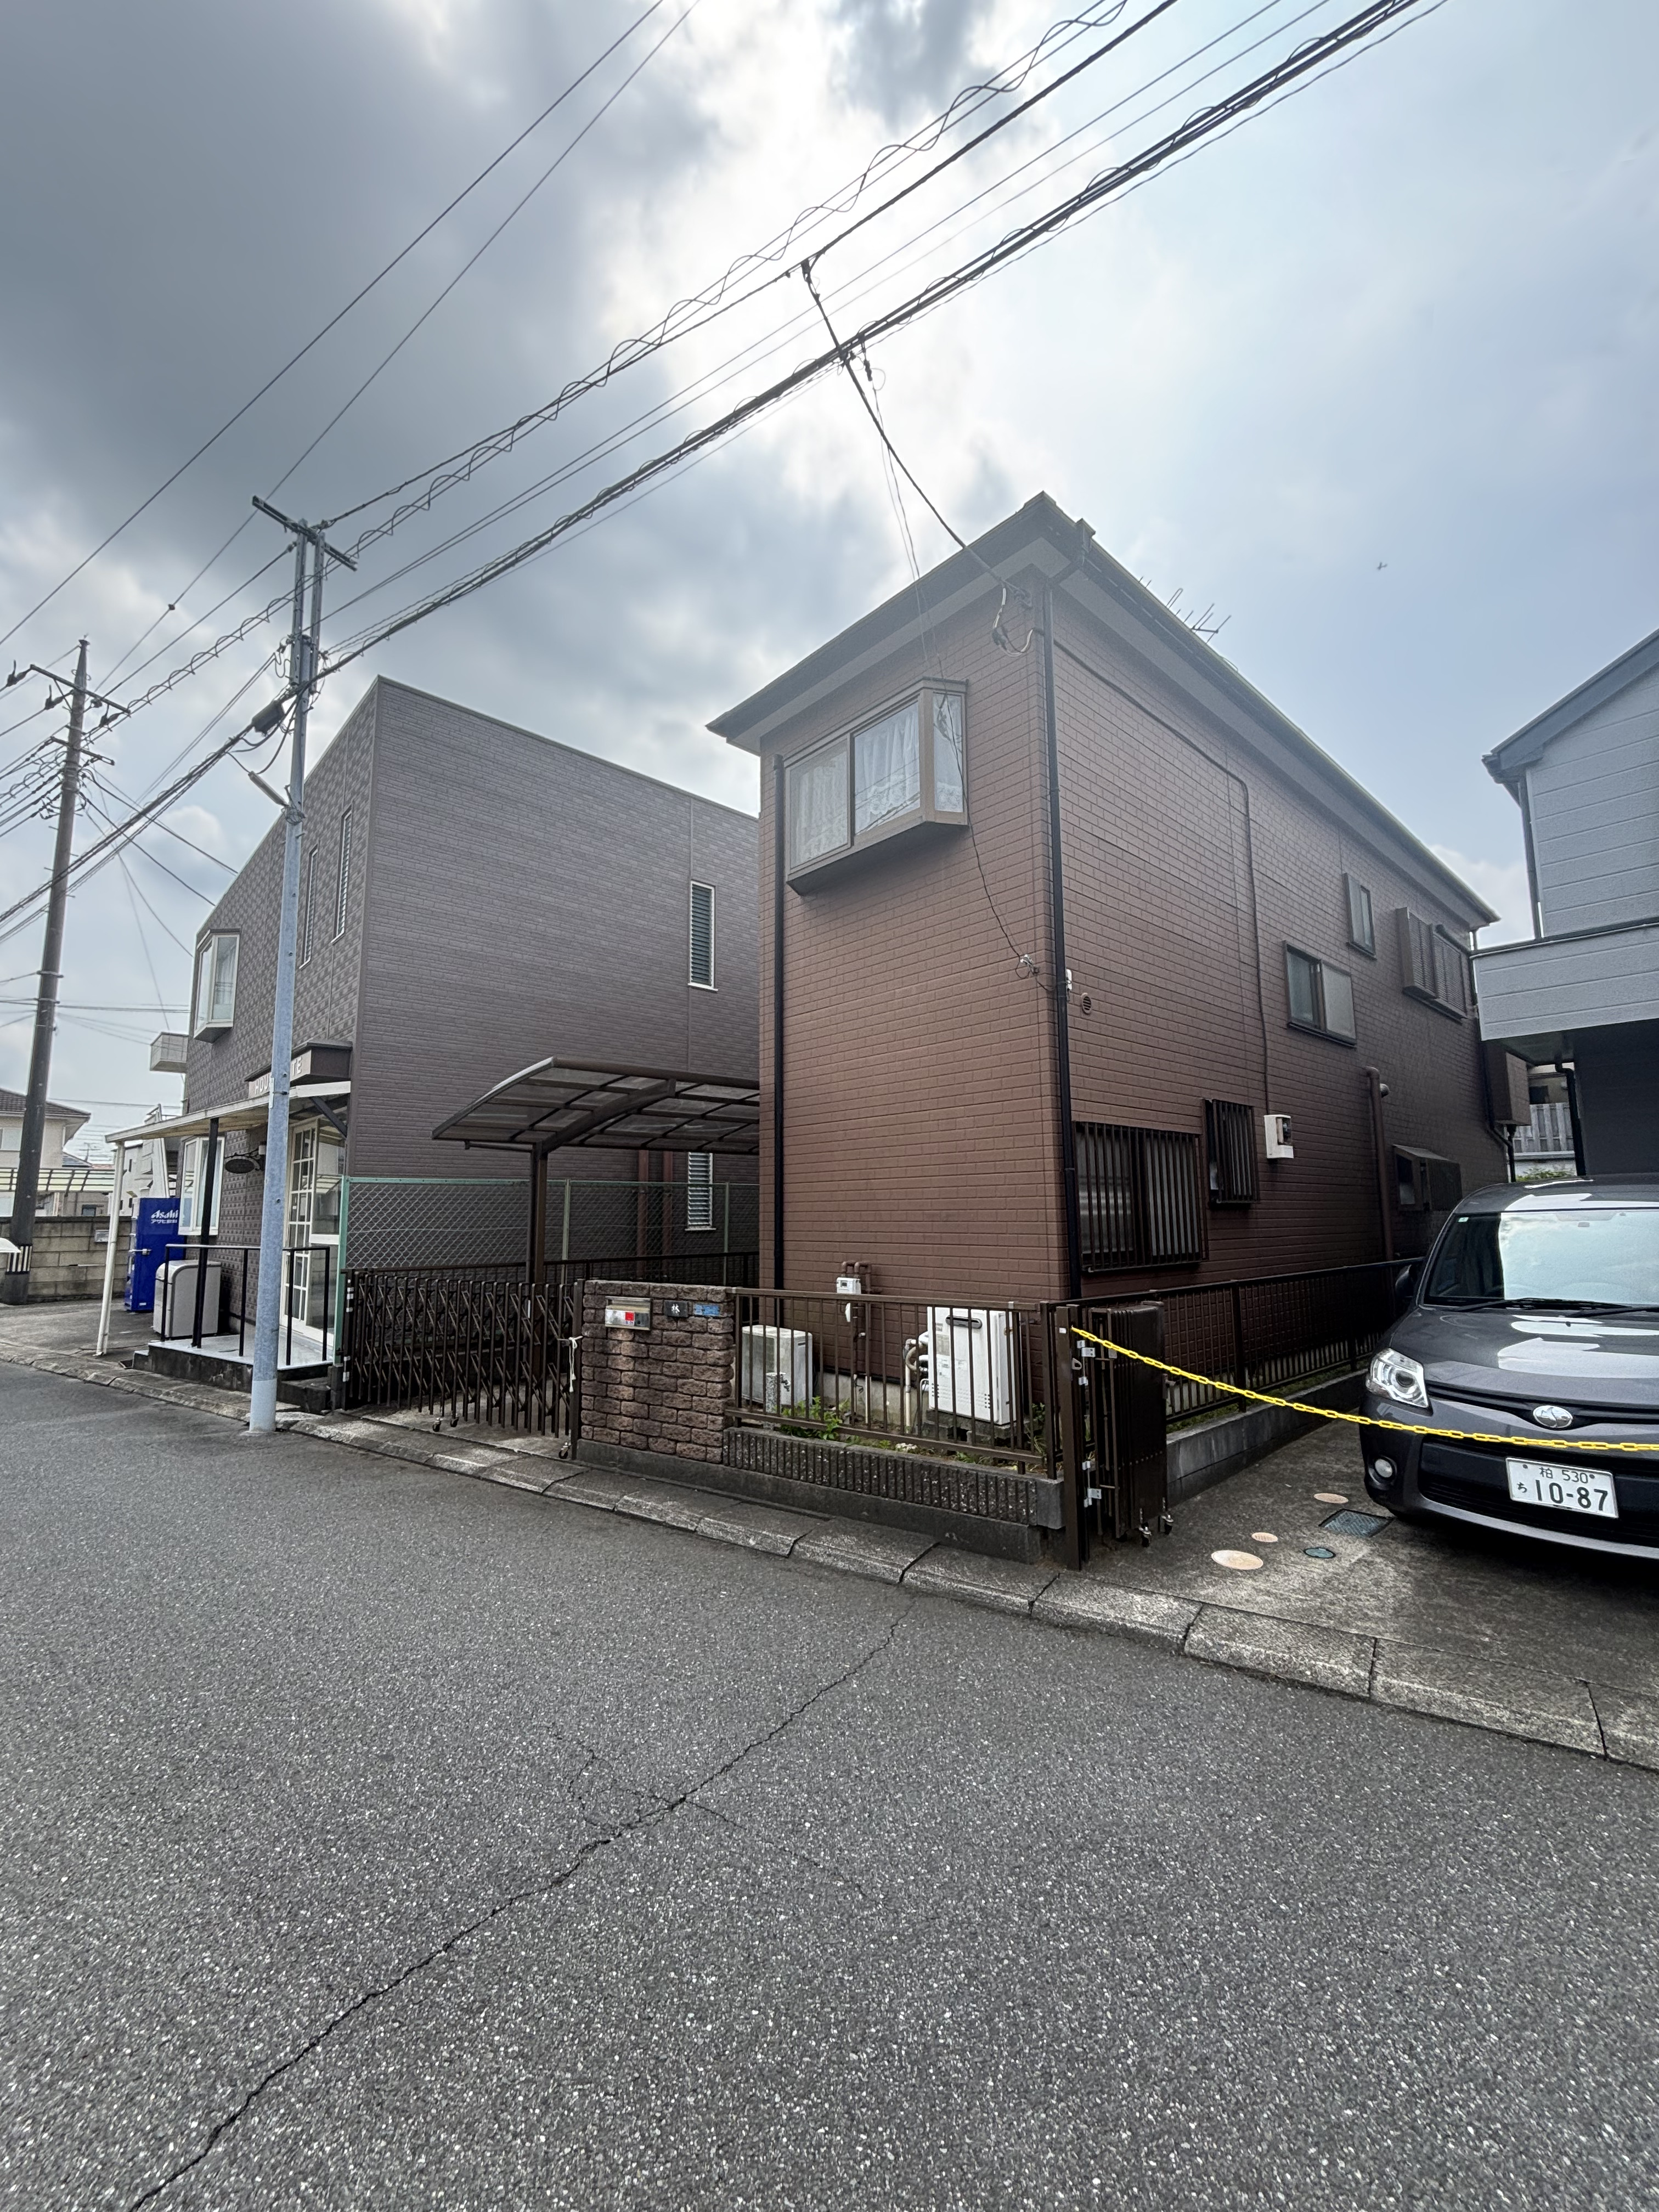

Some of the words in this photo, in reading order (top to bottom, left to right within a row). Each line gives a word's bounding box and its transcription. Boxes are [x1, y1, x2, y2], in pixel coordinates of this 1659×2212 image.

[255, 1074, 270, 1095] HOU
[151, 1210, 179, 1218] Asahi
[1539, 1467, 1553, 1479] 柏
[1561, 1469, 1589, 1483] 530
[1517, 1482, 1527, 1493] ち
[1535, 1479, 1608, 1511] 10-87
